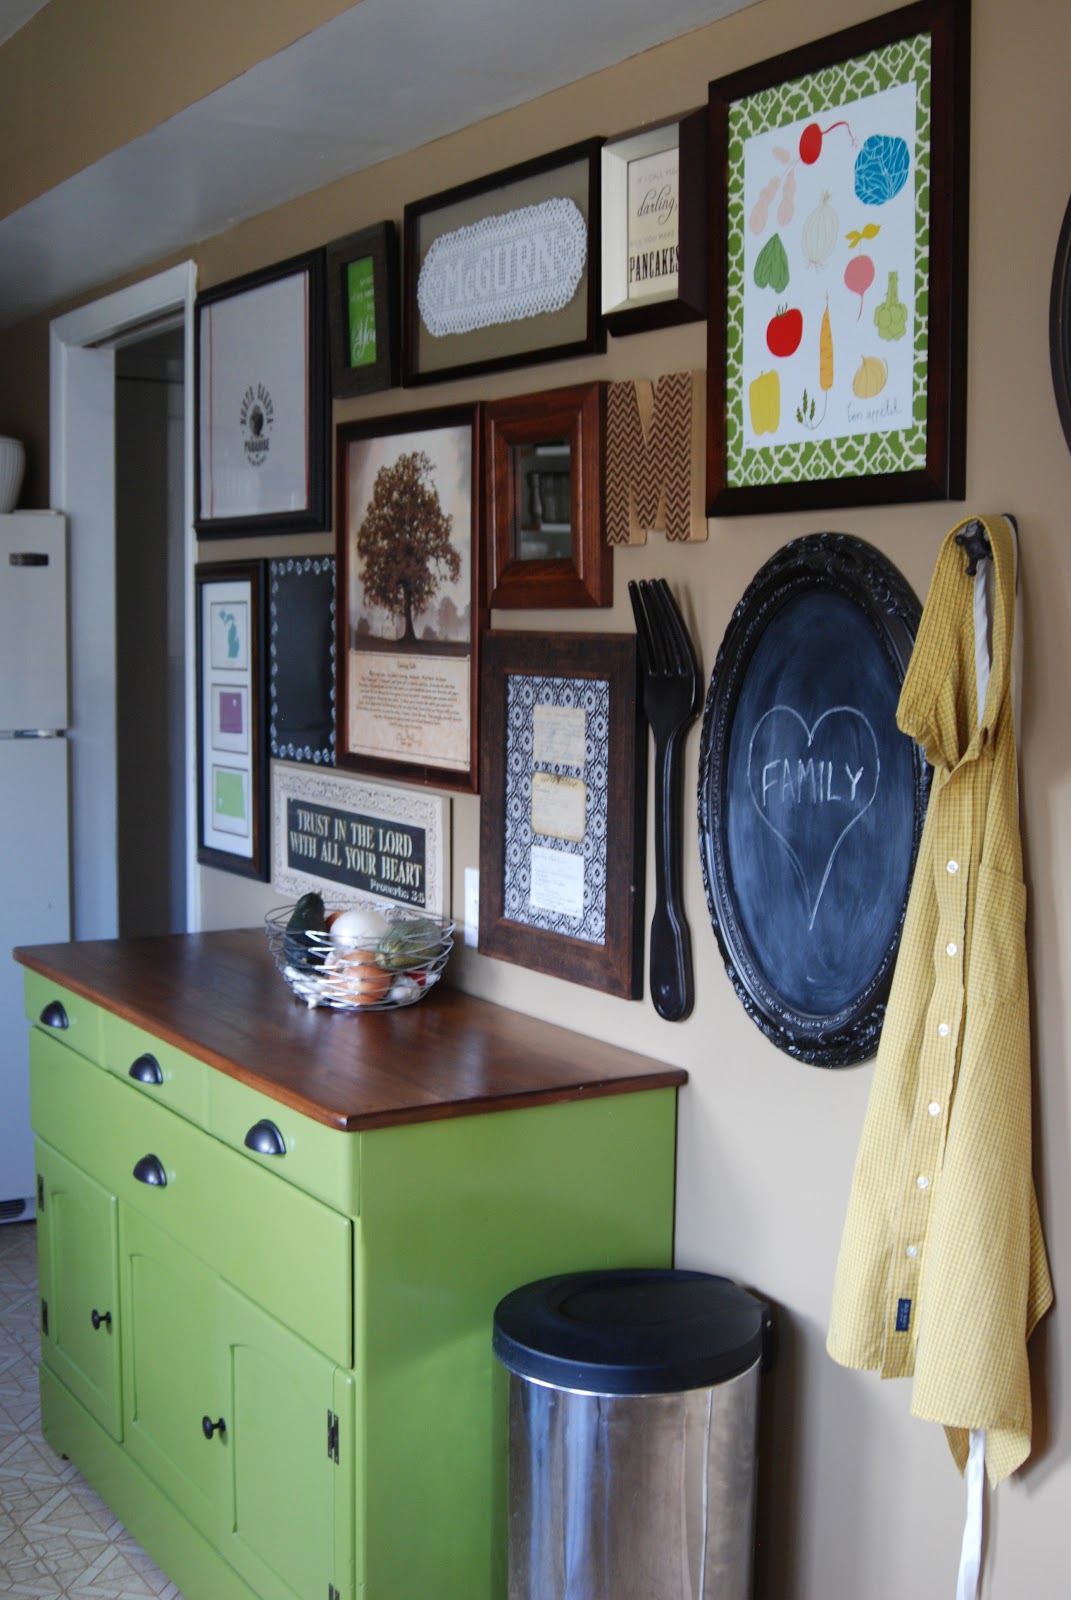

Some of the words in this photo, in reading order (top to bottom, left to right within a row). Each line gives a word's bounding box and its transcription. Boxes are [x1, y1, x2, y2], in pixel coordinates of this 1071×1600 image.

[637, 184, 678, 226] darling,
[629, 246, 679, 284] PANCAKES
[847, 401, 864, 423] bon
[762, 757, 864, 806] FAMILY
[297, 809, 330, 836] TRUST
[334, 818, 346, 842] IN
[351, 823, 375, 849] THE
[379, 829, 412, 858] LORD
[290, 831, 317, 859] WITH
[320, 841, 342, 867] ALL
[345, 846, 376, 876] YOUR
[381, 856, 422, 888] HEART
[370, 878, 409, 900] Proverbs
